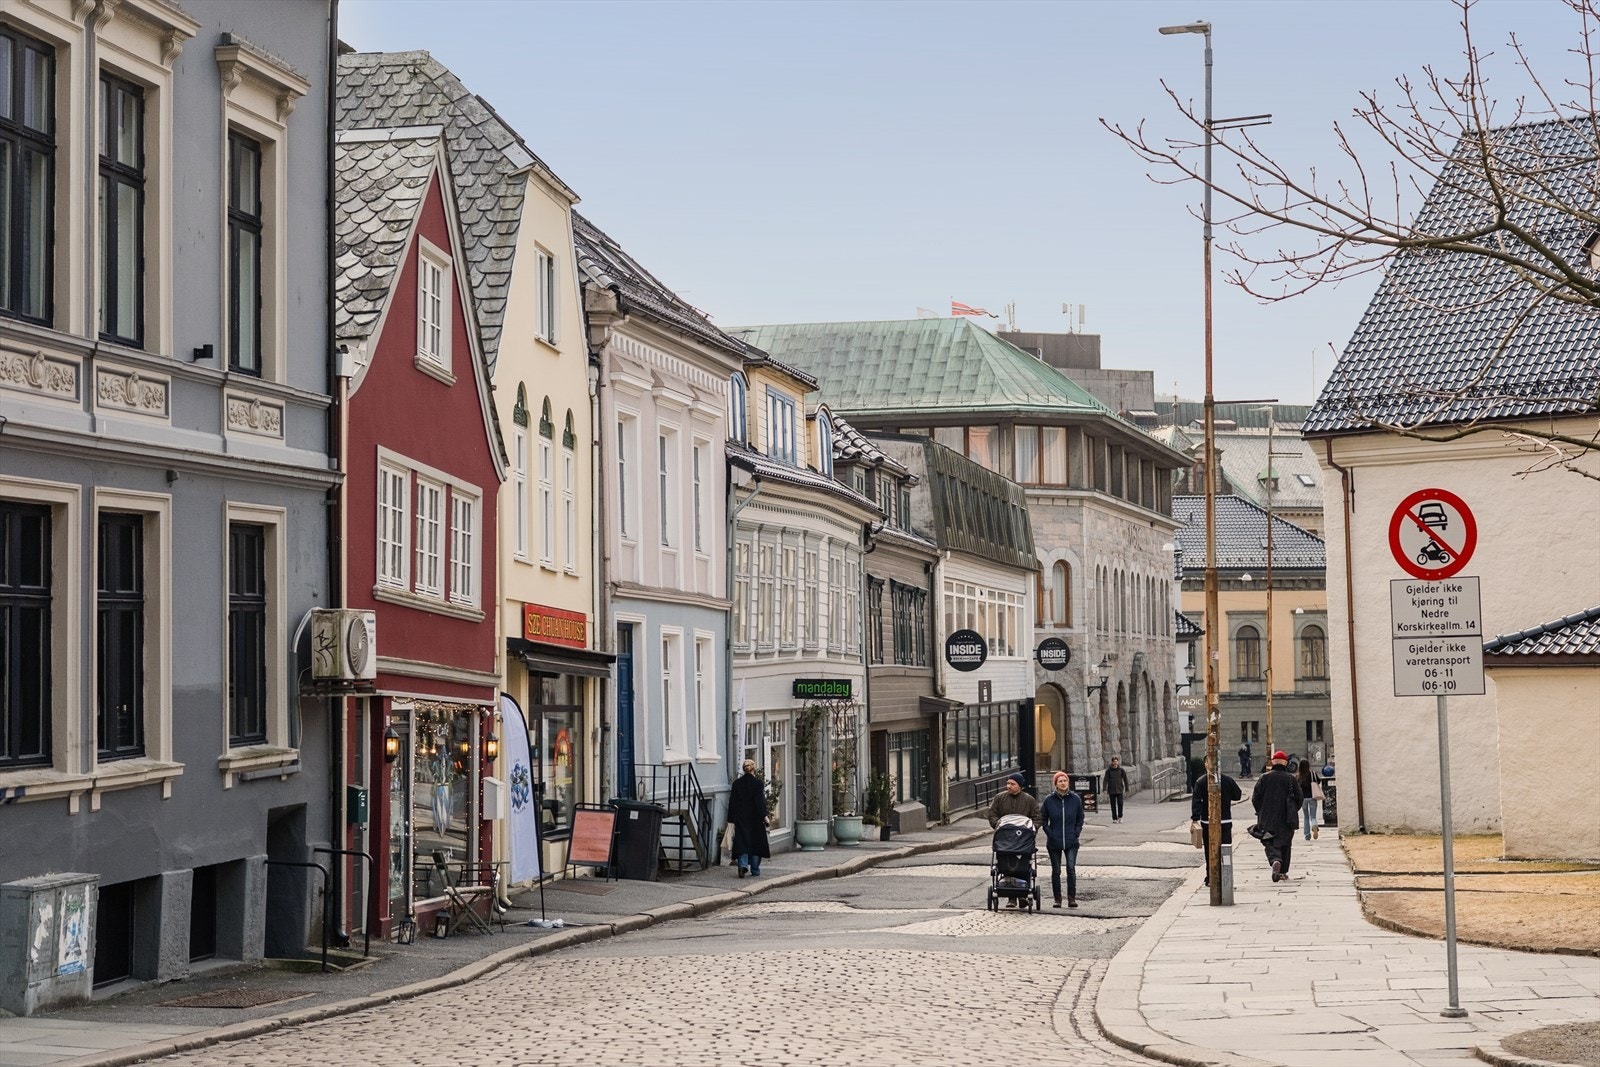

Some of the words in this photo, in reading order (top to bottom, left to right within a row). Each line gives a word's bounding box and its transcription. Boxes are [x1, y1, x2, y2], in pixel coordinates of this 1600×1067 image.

[1406, 584, 1440, 596] Gjelder
[1443, 584, 1463, 593] ikke
[1411, 597, 1444, 608] kjøring
[1448, 596, 1458, 605] til
[1421, 609, 1450, 618] Nedre
[528, 613, 541, 635] SZE
[542, 615, 563, 639] CHUAN
[564, 619, 584, 641] HOUSE
[1397, 621, 1463, 632] Korskirkeallm.
[1465, 620, 1476, 630] 14
[949, 644, 982, 655] INSIDE
[1040, 649, 1067, 658] INSIDE
[1408, 644, 1443, 655] Gjelder
[1446, 643, 1466, 652] ikke
[1406, 656, 1471, 667] varetransport
[797, 681, 849, 697] mandalay
